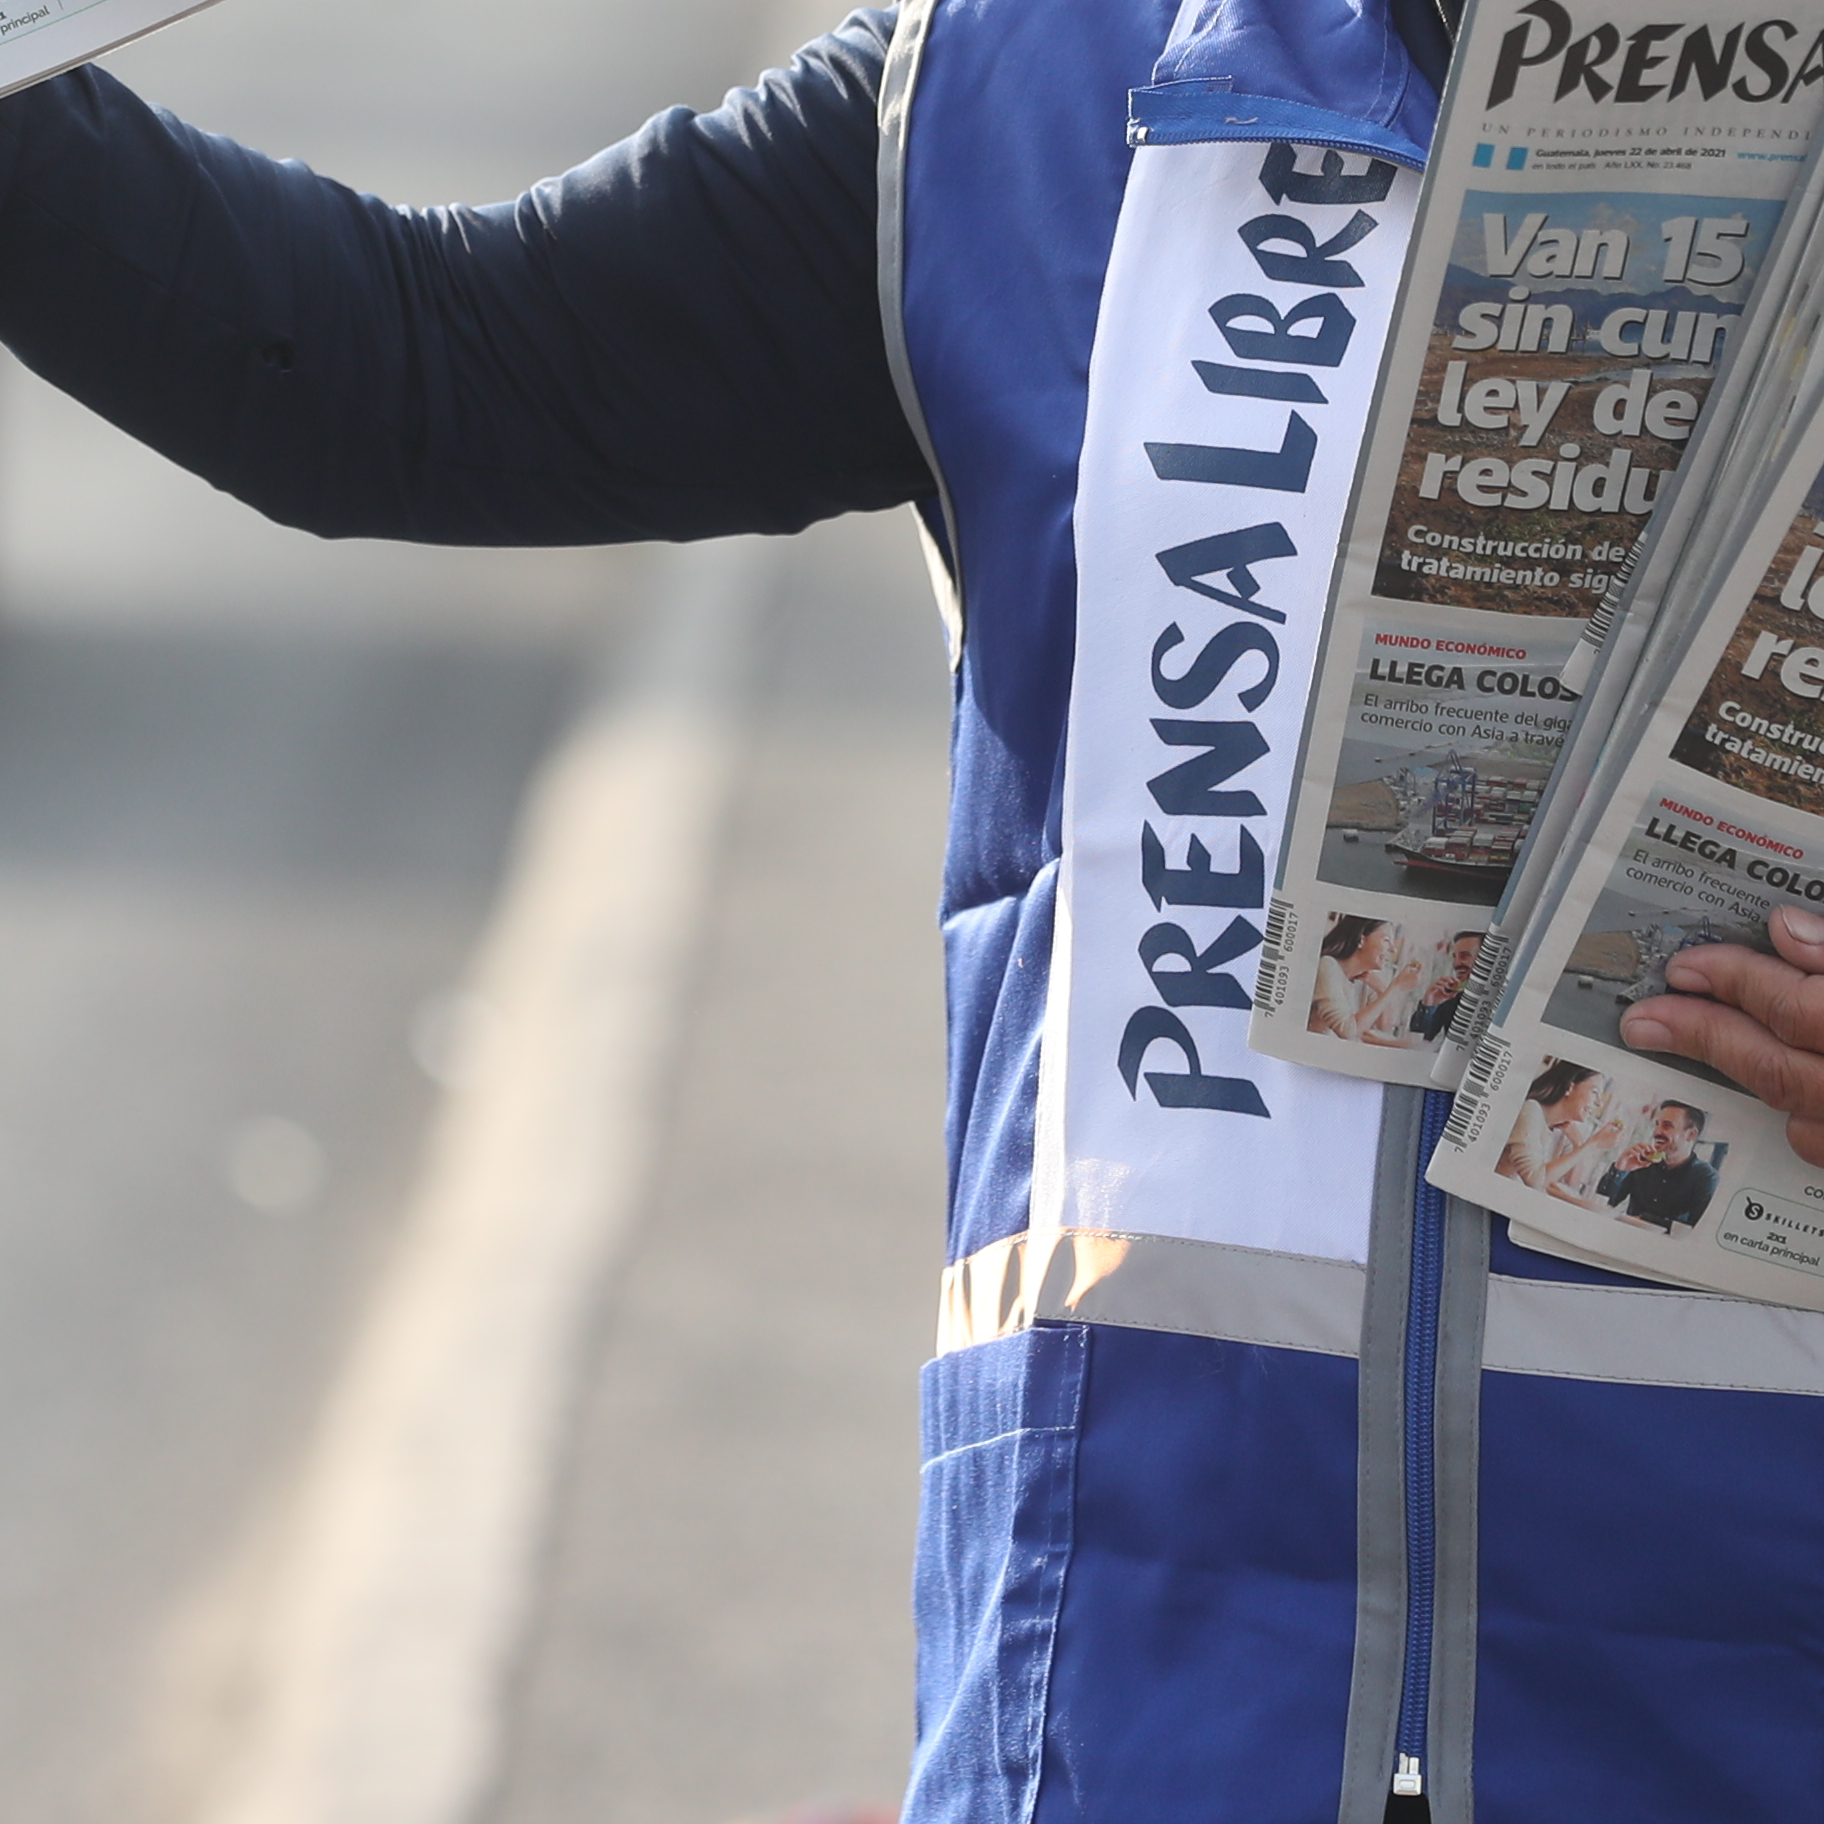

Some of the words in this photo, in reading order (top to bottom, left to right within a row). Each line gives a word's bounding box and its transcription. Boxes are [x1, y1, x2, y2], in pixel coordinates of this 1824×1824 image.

[1480, 211, 1632, 284] Van
[1663, 216, 1751, 287] 15
[1143, 142, 1397, 493] LIBRE
[1451, 281, 1575, 357] sin
[1436, 359, 1572, 449] ley
[1592, 366, 1700, 443] de
[1406, 523, 1584, 562] Construcción
[1591, 539, 1626, 563] de
[1368, 657, 1466, 691] LLEGA
[1374, 632, 1431, 650] MUNDO
[1434, 636, 1527, 660] ECONÓMICO
[1360, 711, 1433, 732] comercio
[1437, 722, 1466, 736] con
[1470, 724, 1504, 741] Asia
[1507, 731, 1519, 743] a
[1363, 692, 1379, 707] El
[1383, 697, 1429, 714] arribo
[1434, 701, 1509, 724] frecuente
[1513, 711, 1539, 727] del
[1118, 521, 1300, 1120] PRENSA
[1643, 816, 1742, 870] LLEGA
[1656, 796, 1716, 829] MUNDO
[1714, 817, 1807, 861] ECONÓMICO
[1624, 866, 1695, 896] comercio
[1696, 888, 1726, 908] con
[1727, 901, 1763, 923] Asia
[1632, 847, 1650, 864] El
[1650, 853, 1696, 878] arribo
[1696, 869, 1774, 909] frecuente
